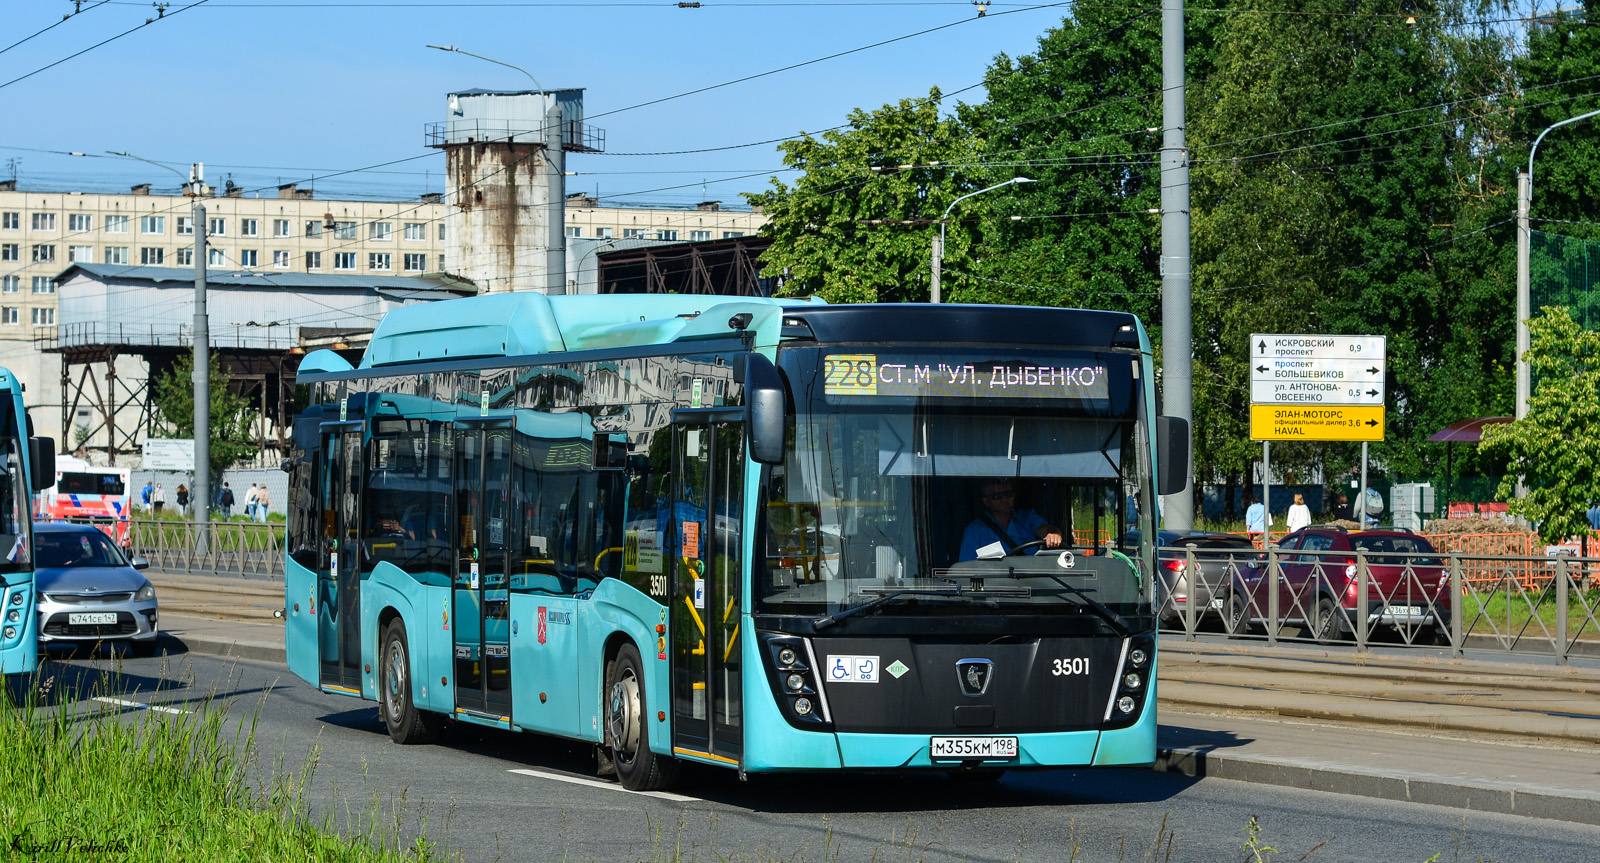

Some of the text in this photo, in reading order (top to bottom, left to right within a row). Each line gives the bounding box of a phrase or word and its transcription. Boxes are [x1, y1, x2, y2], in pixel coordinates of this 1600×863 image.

[1275, 338, 1335, 347] ИСКРОВСКИЙ
[1349, 344, 1362, 353] 0,9
[824, 359, 873, 387] 228
[879, 363, 1104, 389] СТ.М "УЛ. ДЫБЕНКО"
[1274, 370, 1344, 379] БОЛЬШЕВИКОВ
[1289, 383, 1341, 392] АНТОНОВА-
[1274, 393, 1323, 402] ОВСЕЕНКО
[1348, 389, 1361, 398] 0,5
[1274, 410, 1343, 419] ЭЛАН-МОТОРС
[1348, 419, 1361, 428] 3,6
[1274, 427, 1305, 435] HAVAL
[650, 575, 667, 596] 3501
[1052, 658, 1090, 676] 3501
[936, 739, 1013, 754] М355КМ 198
